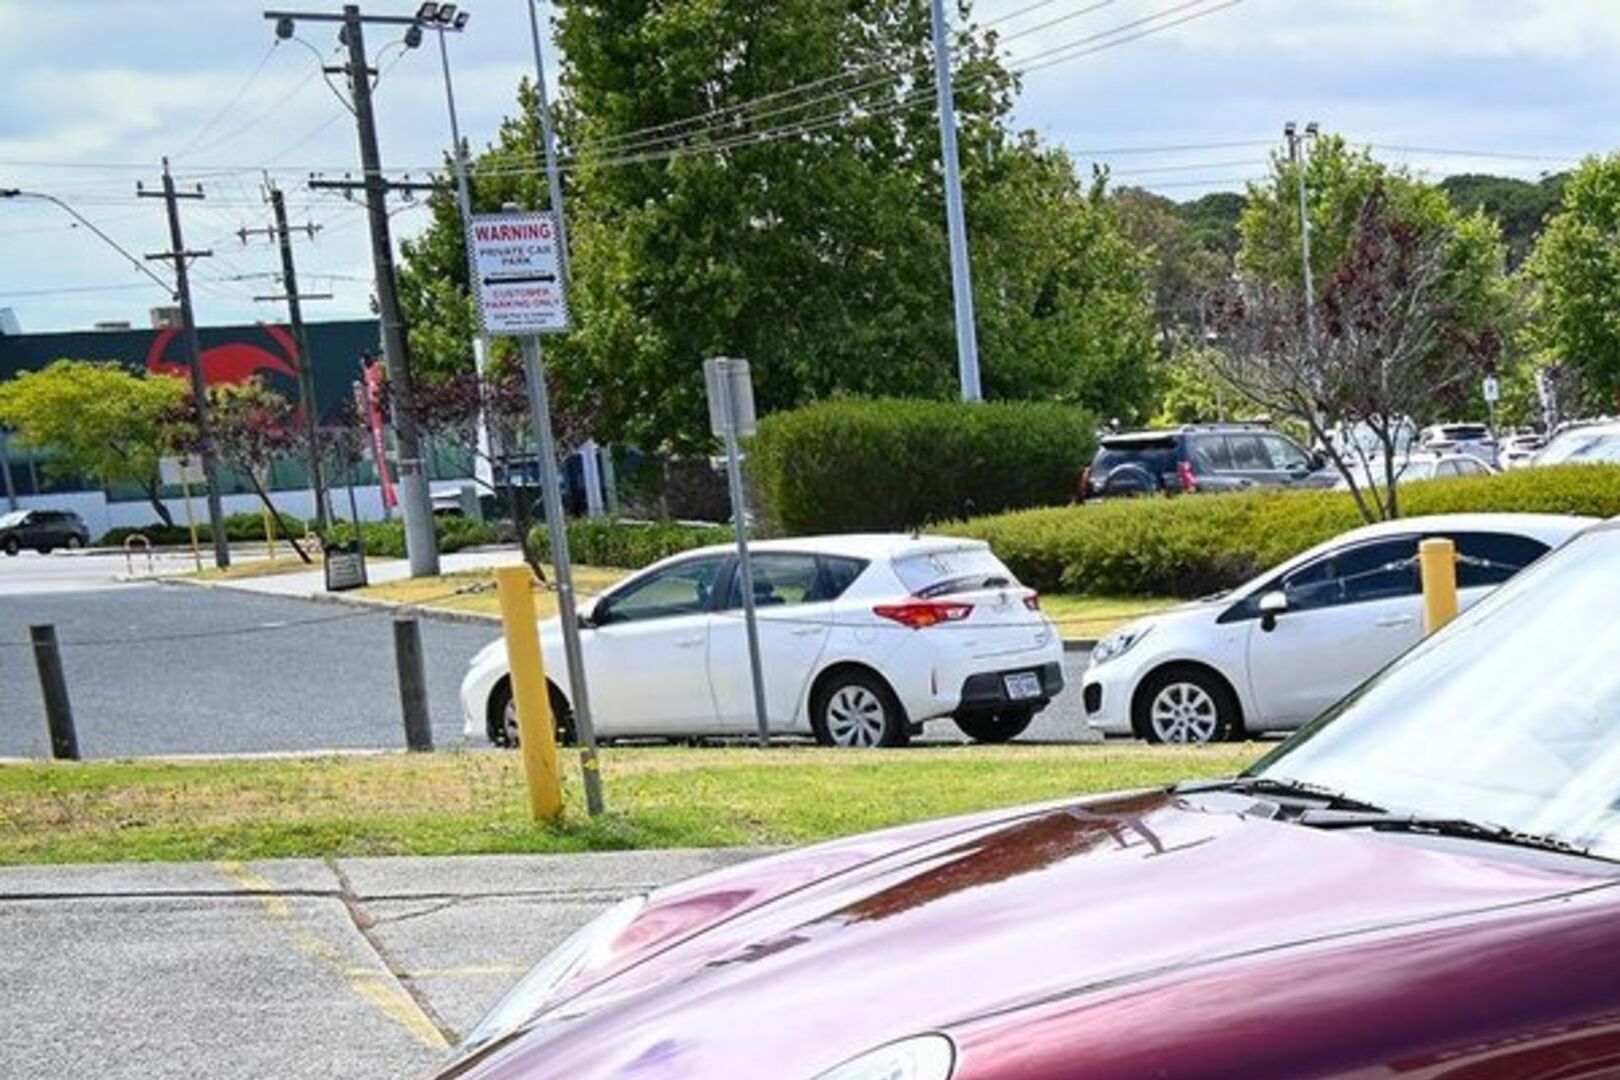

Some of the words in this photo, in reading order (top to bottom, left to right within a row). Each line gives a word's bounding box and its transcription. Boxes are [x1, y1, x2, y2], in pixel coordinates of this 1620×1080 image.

[475, 223, 551, 241] WARNING
[479, 247, 524, 256] PRIVATE
[527, 245, 551, 255] CAR
[501, 257, 532, 266] PARK
[492, 288, 550, 298] CUSTOMER
[485, 299, 530, 309] PARKING
[534, 298, 560, 308] ONLY
